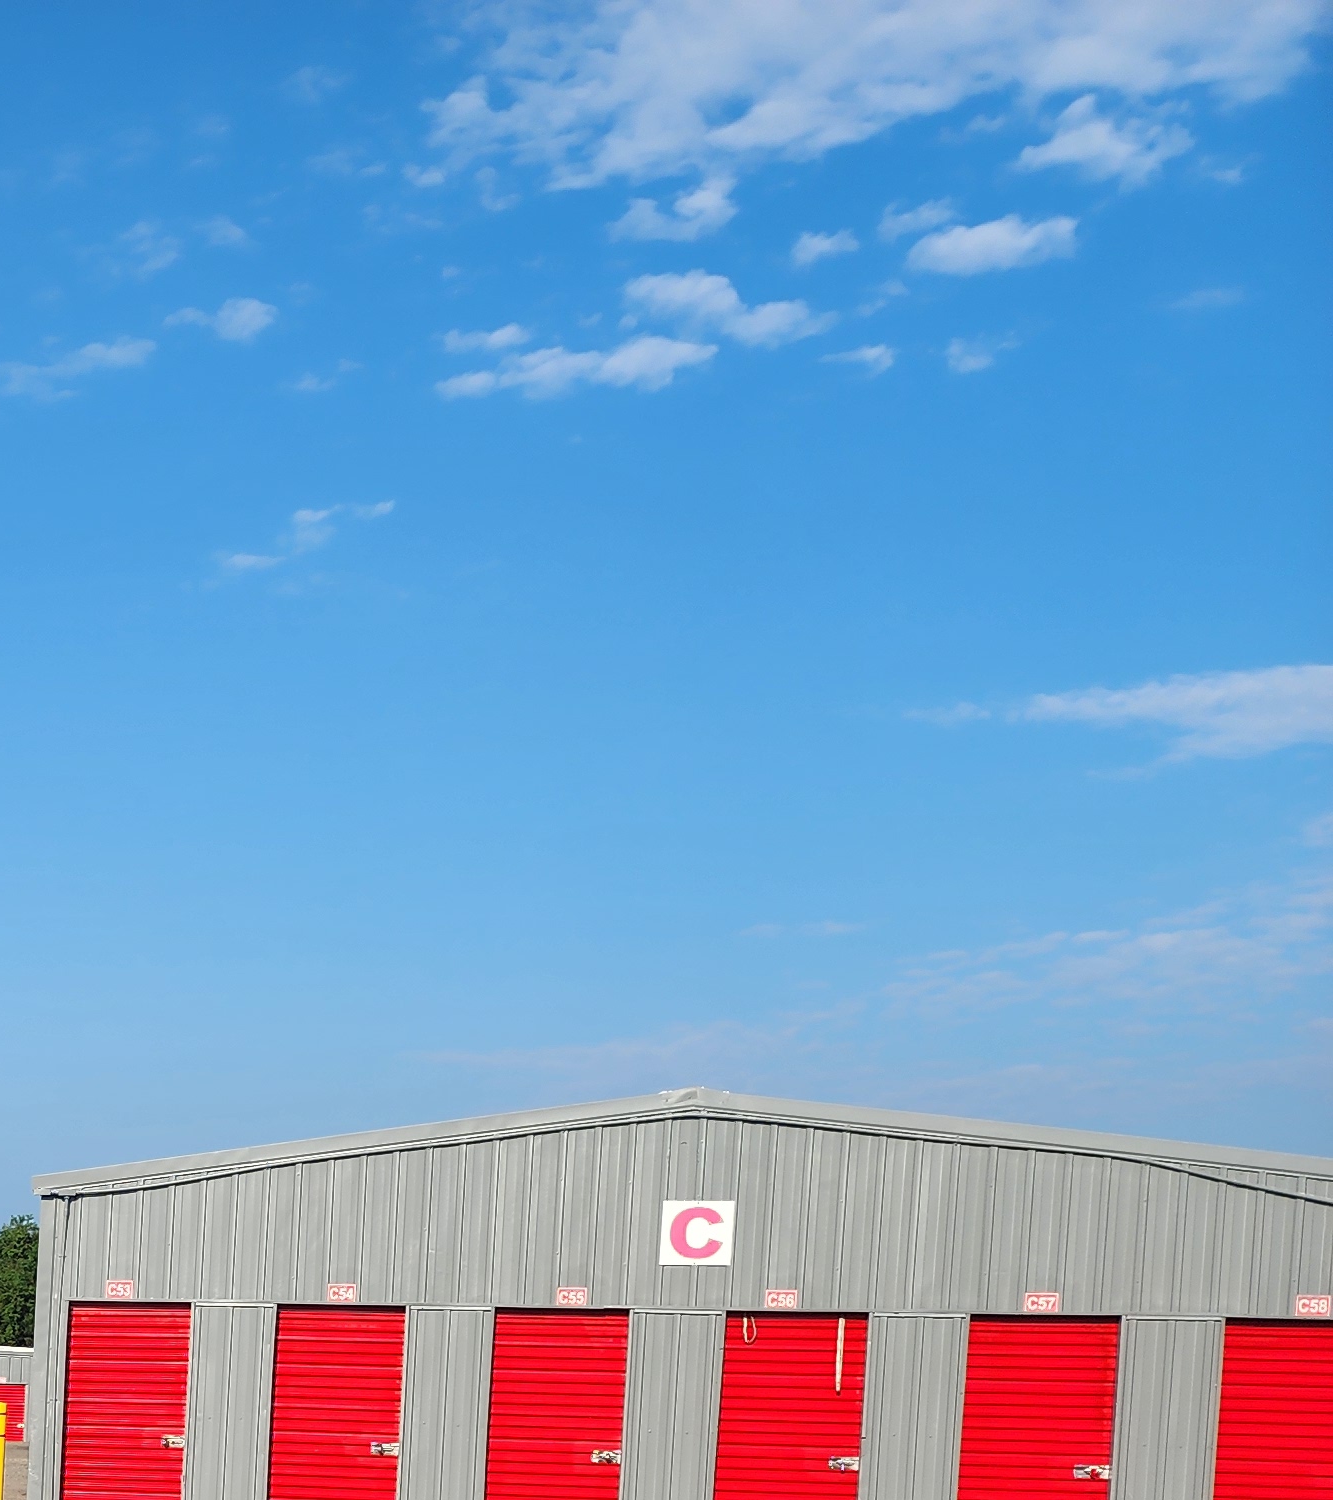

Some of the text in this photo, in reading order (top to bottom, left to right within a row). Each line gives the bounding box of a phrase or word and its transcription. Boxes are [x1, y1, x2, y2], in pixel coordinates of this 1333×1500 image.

[669, 1206, 724, 1259] C
[108, 1283, 131, 1297] C53
[329, 1287, 354, 1301] C54
[559, 1291, 585, 1305] C55
[767, 1294, 795, 1308] C56
[1027, 1296, 1056, 1311] C57
[1298, 1299, 1328, 1313] C58
